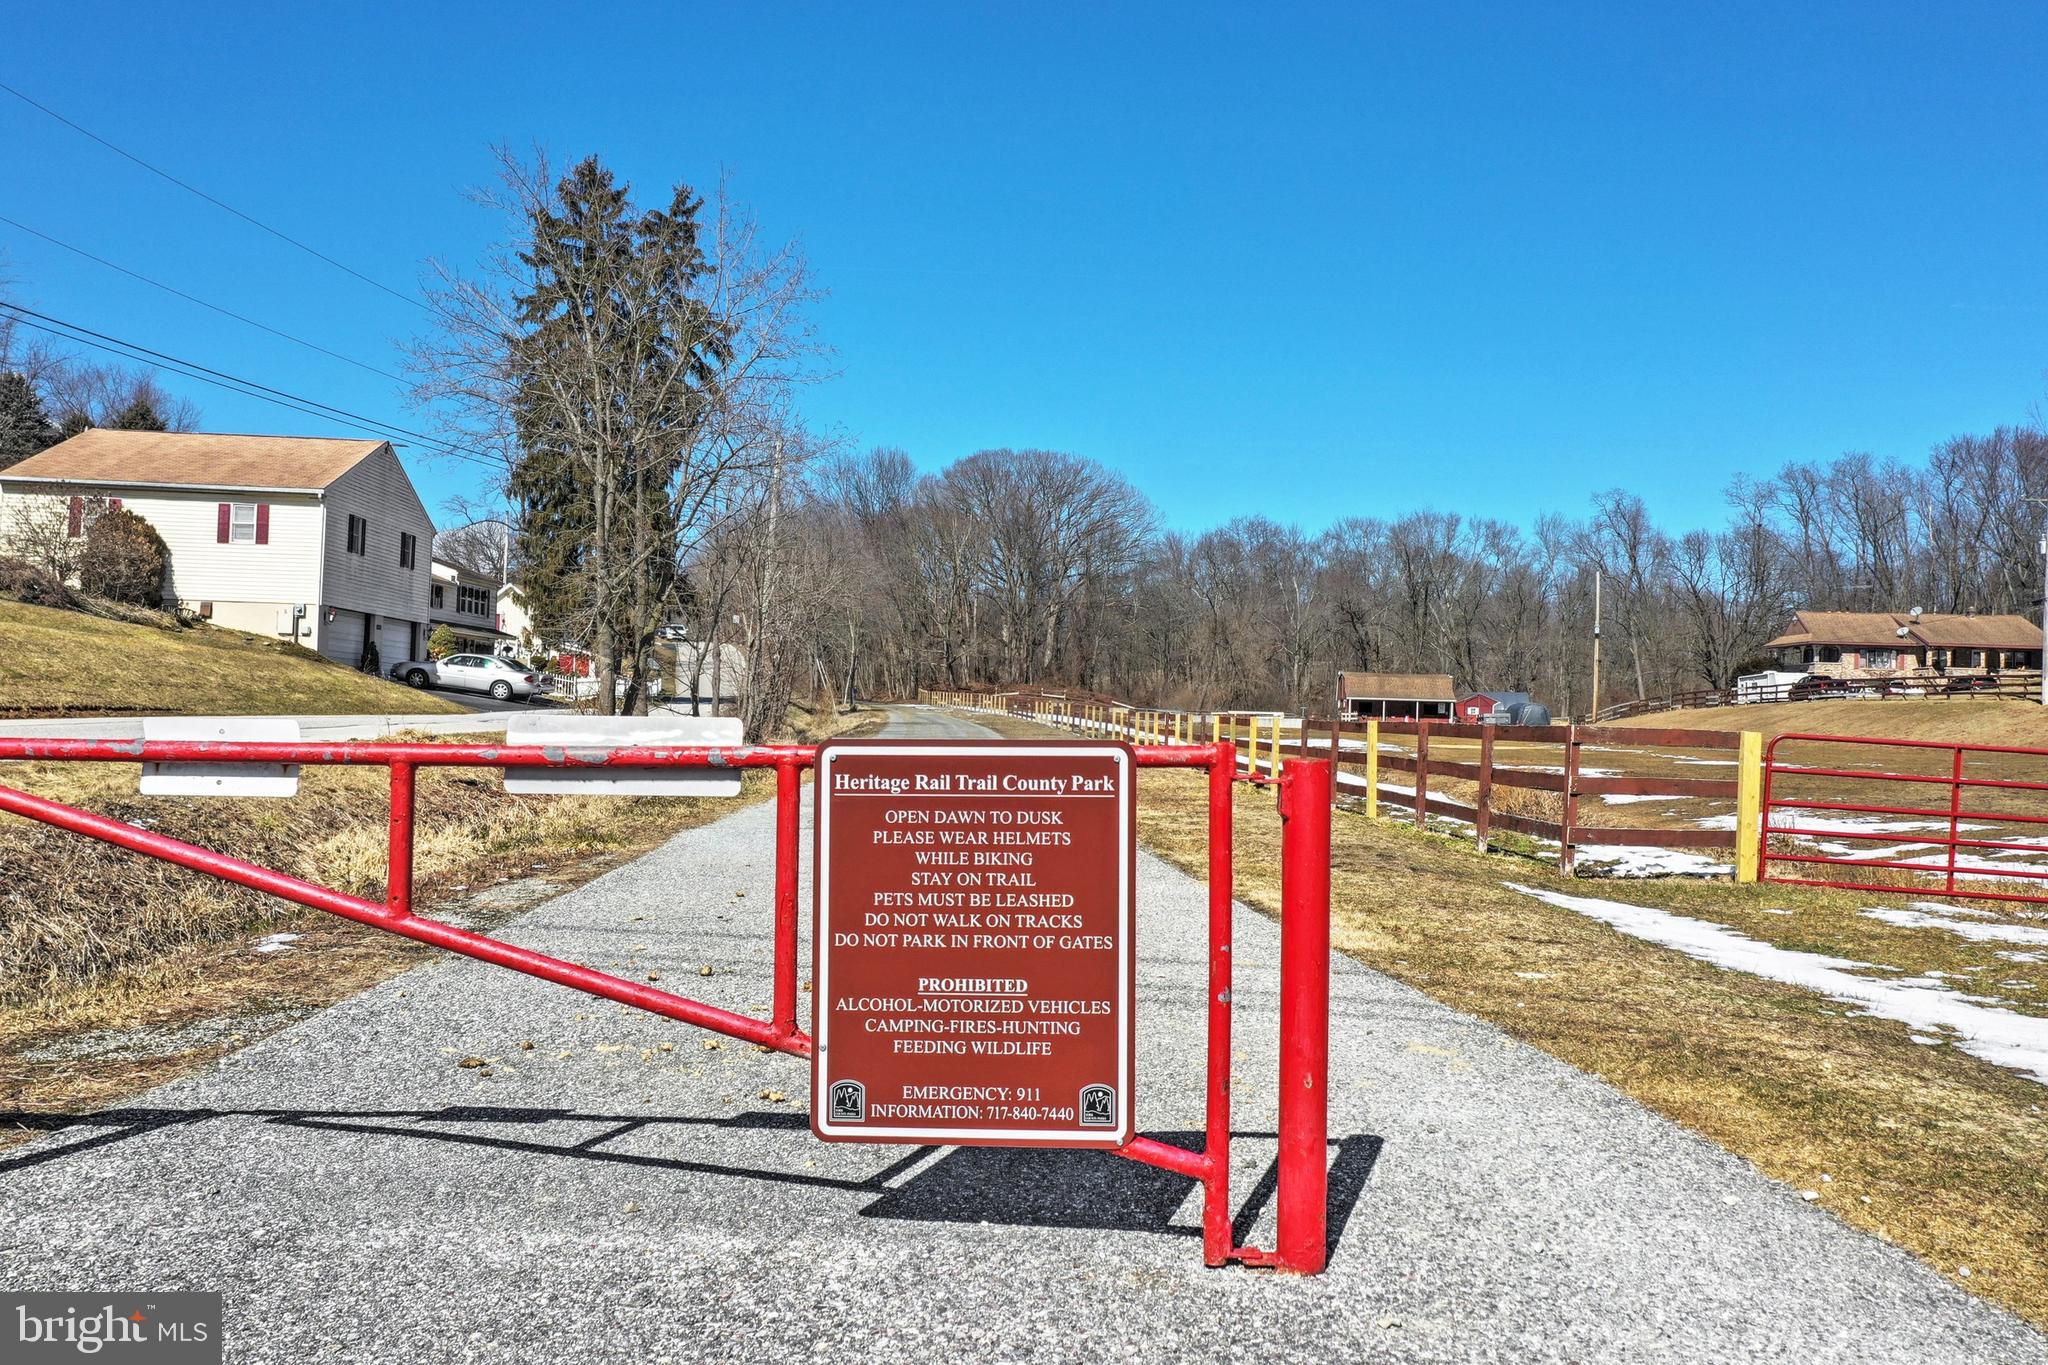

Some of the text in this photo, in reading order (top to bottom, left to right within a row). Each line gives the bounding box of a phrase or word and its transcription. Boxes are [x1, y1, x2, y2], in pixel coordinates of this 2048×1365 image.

[835, 774, 1114, 794] Heritage Rail Trail County Park
[885, 810, 1063, 824] OPEN DAWN TO DUSK
[873, 831, 1071, 845] PLEASE WEAR HELMETS
[915, 852, 1032, 865] WHILE BIKING
[912, 872, 1036, 886] STAY ON TRAIL
[874, 893, 1074, 907] PETS MUST BE LEASHED
[865, 913, 1082, 928] DO NOT WALK ON TRACKS
[835, 933, 1113, 949] DO NOT PARK IN FRONT OF GATES
[918, 978, 1027, 992] PROHIBITED
[836, 998, 1110, 1014] ALCOHOL-MOTORIZED VEHICLES
[865, 1019, 1080, 1035] CAMPING-FIRES-HUNTING
[894, 1040, 1051, 1055] FEEDING WILDLIFE
[903, 1086, 1040, 1101] EMERGENCY: 911
[871, 1105, 982, 1119] INFORMATION:
[987, 1106, 1074, 1120] 717-840-7440
